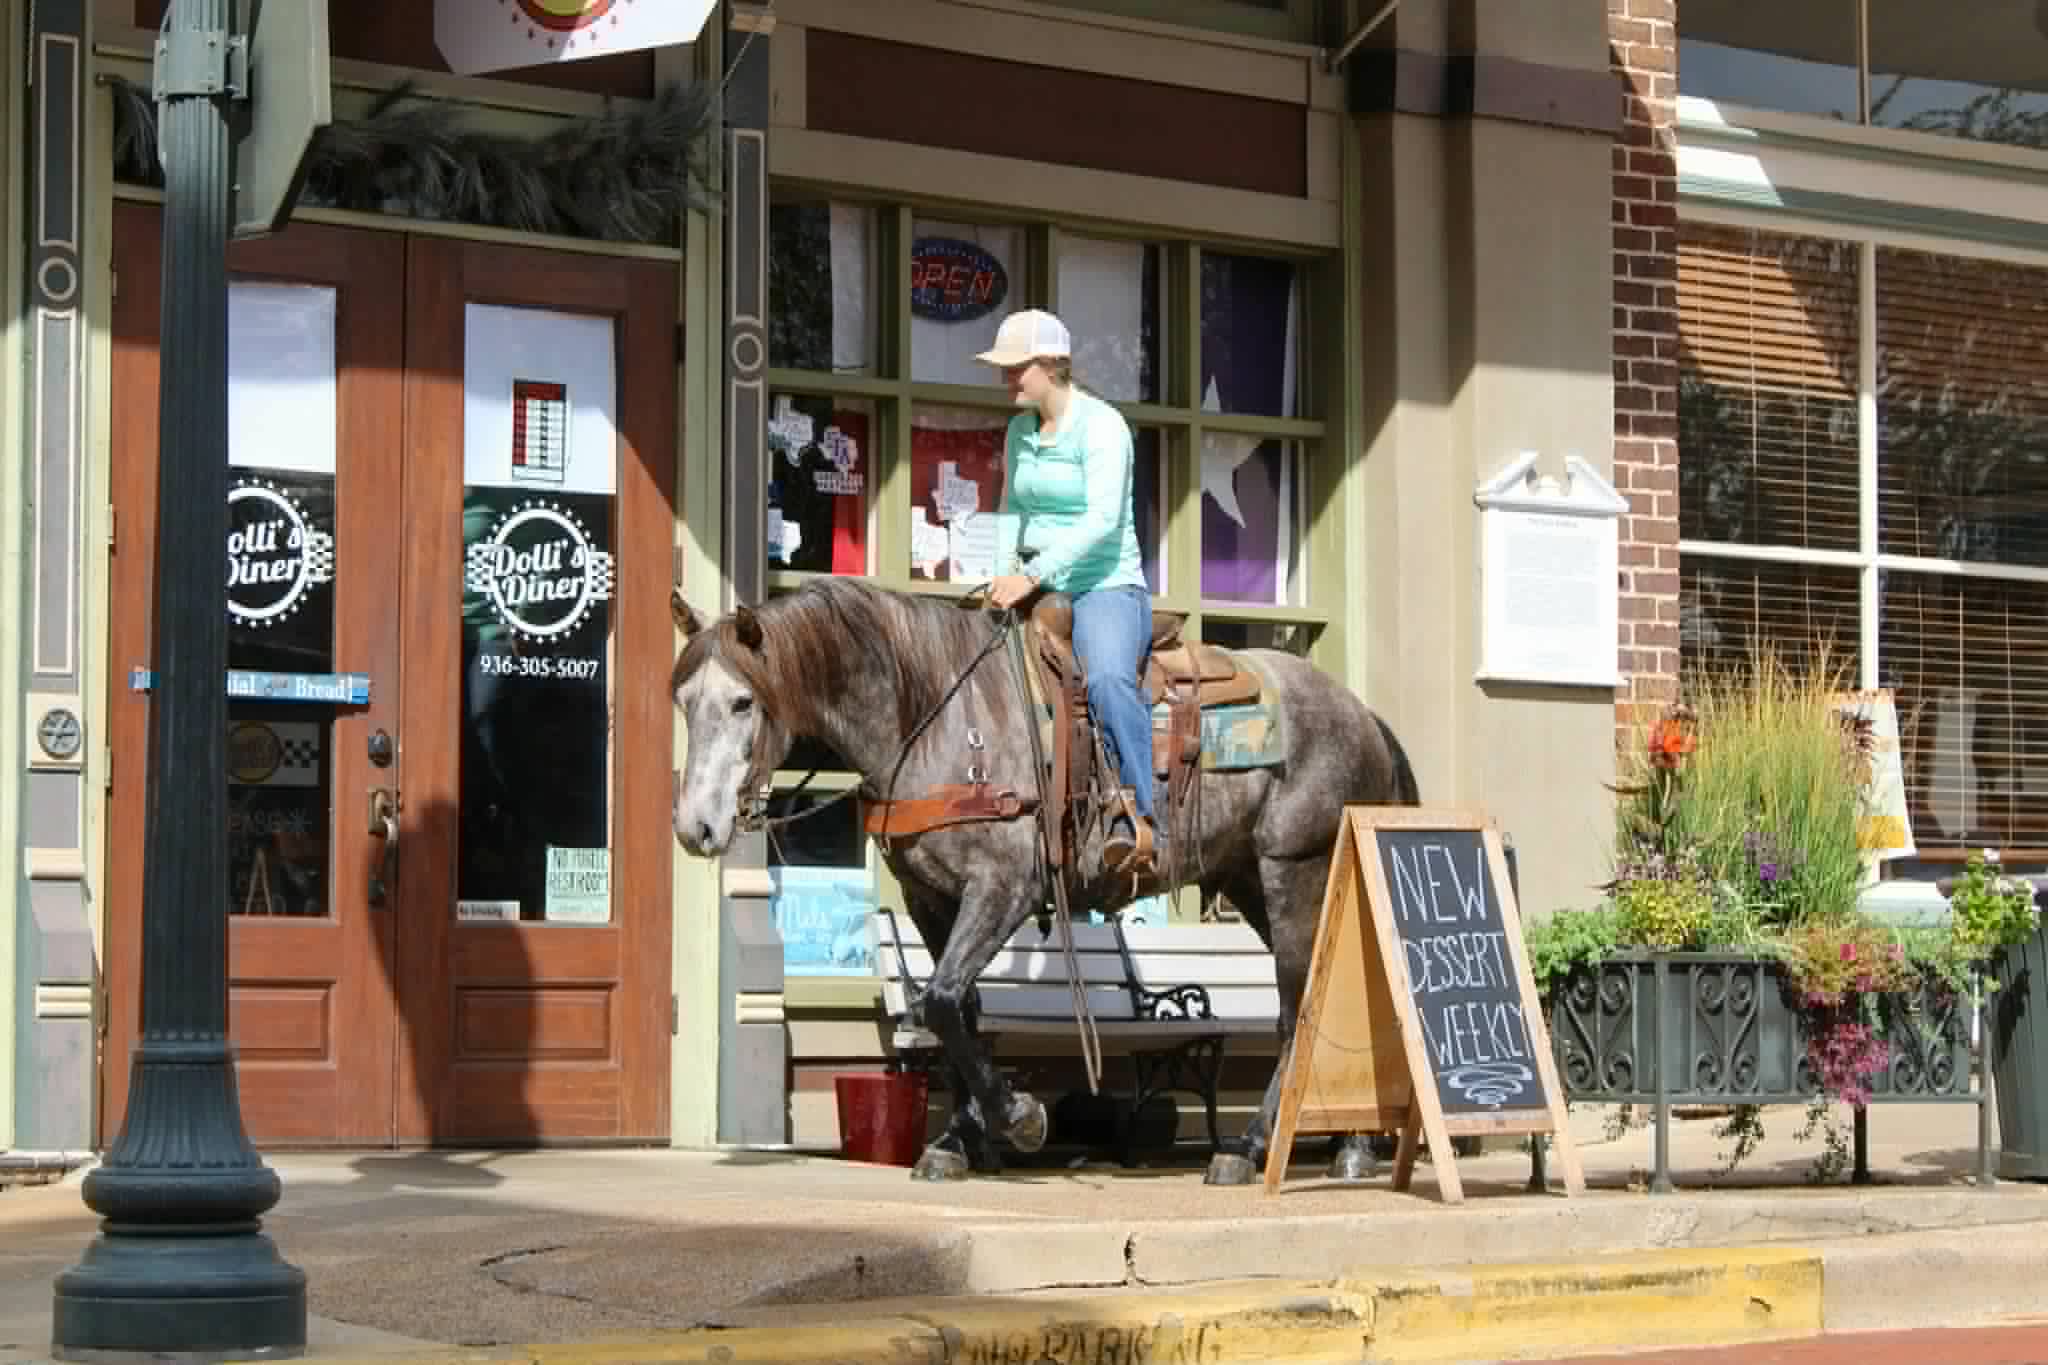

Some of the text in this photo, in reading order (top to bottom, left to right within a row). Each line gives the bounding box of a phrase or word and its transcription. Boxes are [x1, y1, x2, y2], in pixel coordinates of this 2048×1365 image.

[228, 518, 302, 554] olli's
[490, 538, 585, 577] Dolli's
[502, 573, 585, 606] Diner
[479, 654, 600, 680] 936-305-5007
[1391, 845, 1487, 921] NEW
[1401, 931, 1508, 992] DESSERT
[1418, 1001, 1534, 1064] WEEKLY
[1040, 1320, 1224, 1364] PARKNG
